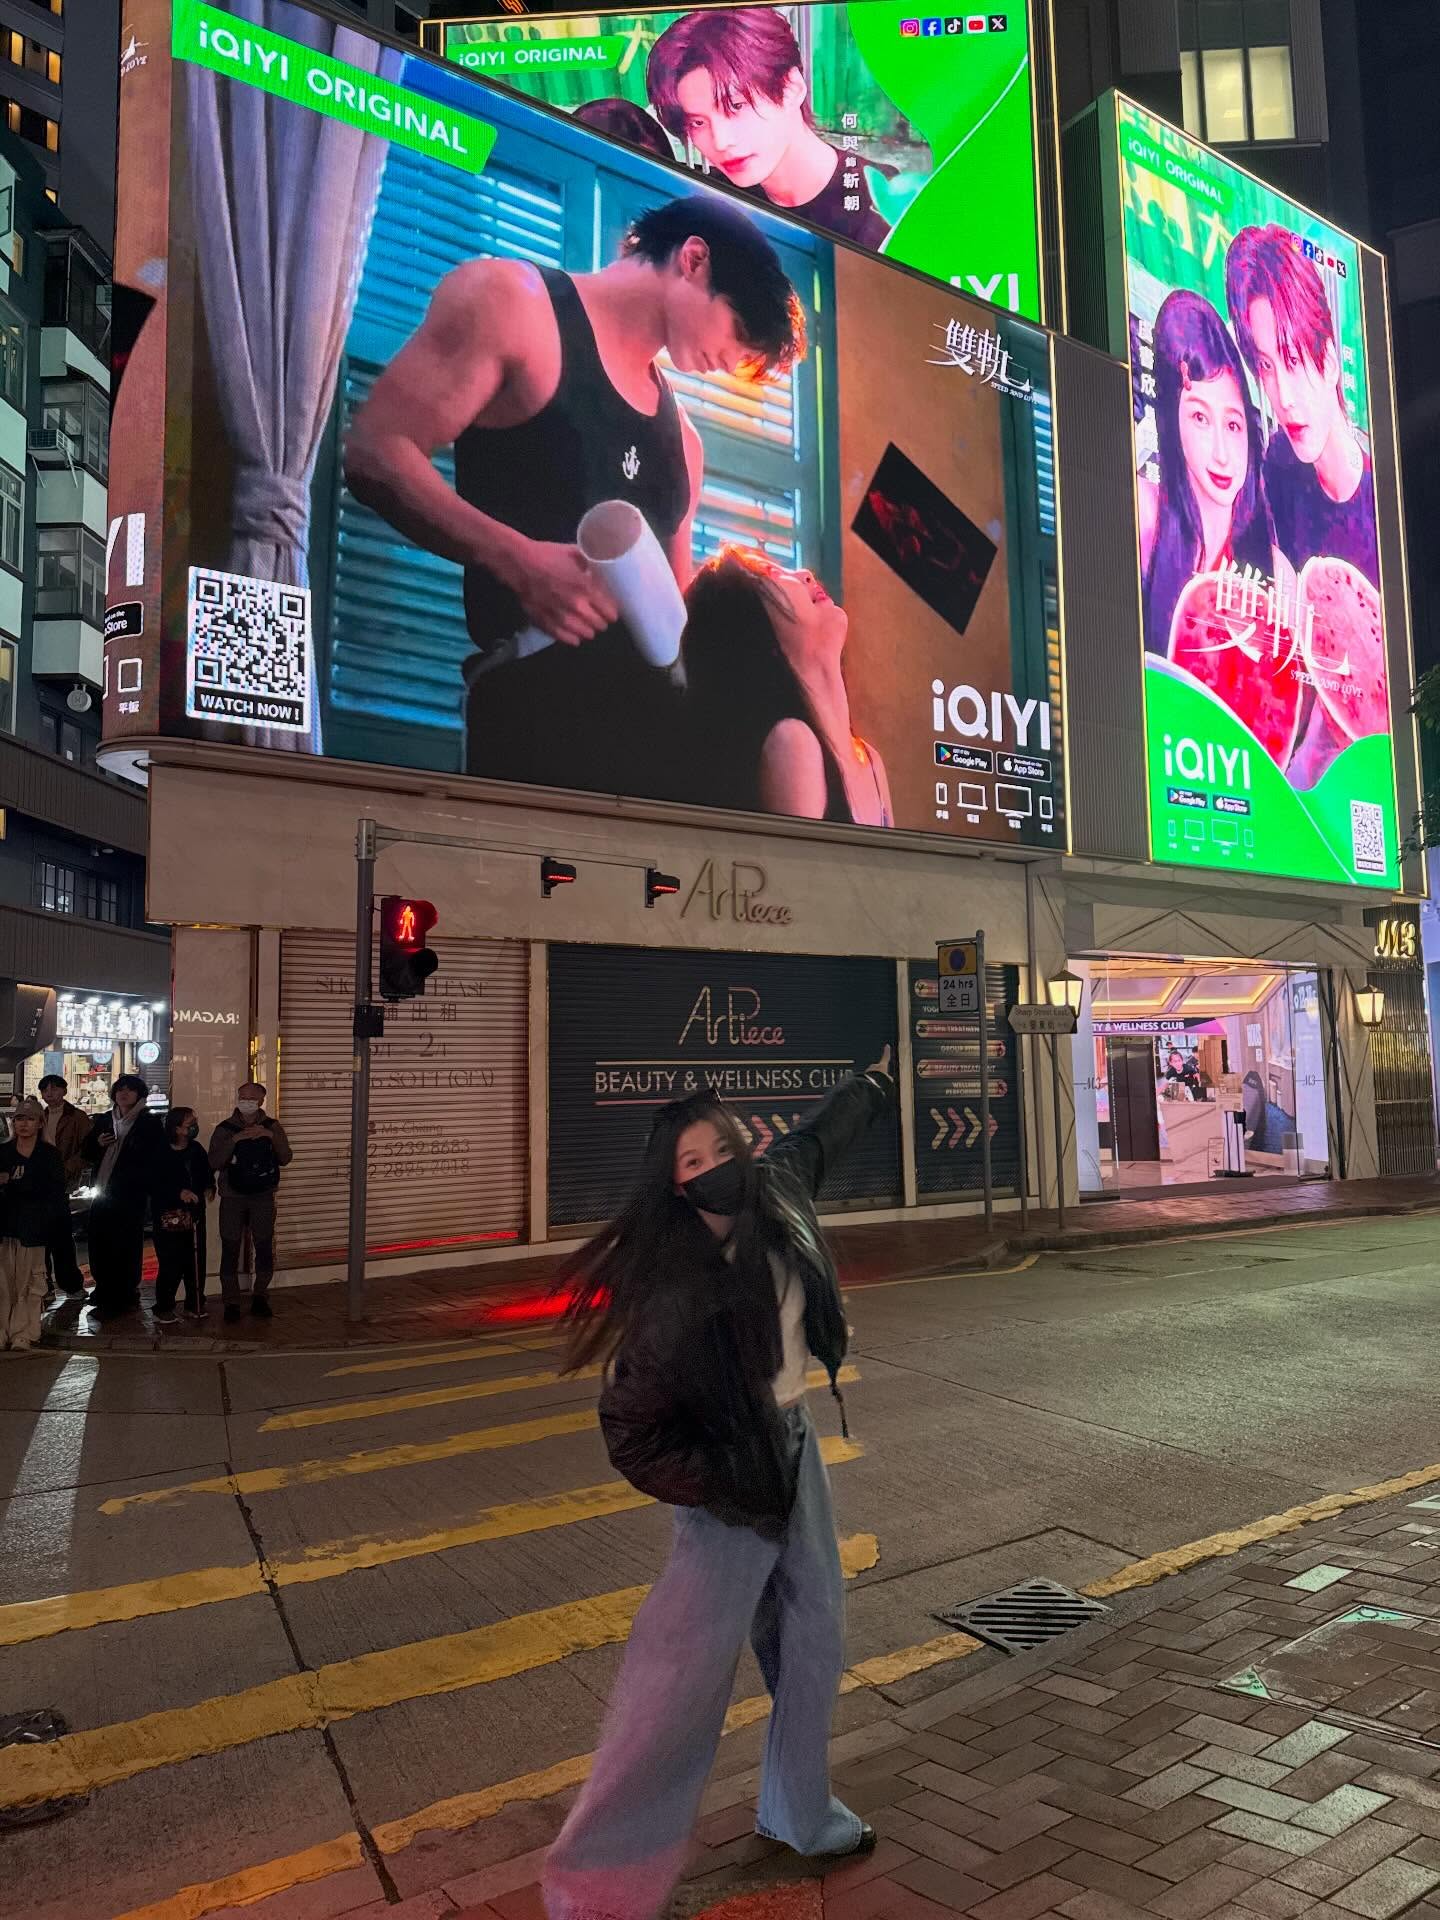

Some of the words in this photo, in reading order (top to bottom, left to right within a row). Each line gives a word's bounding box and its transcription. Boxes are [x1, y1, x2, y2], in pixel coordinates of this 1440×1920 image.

[458, 51, 505, 67] iQIYI
[514, 46, 607, 63] ORIGINAL
[199, 20, 289, 81] iQIYI
[307, 68, 468, 154] ORIGINAL
[1128, 137, 1160, 167] iQIYI
[1165, 159, 1224, 204] ORIGINAL
[200, 694, 254, 715] WATCH
[932, 678, 1051, 750] iQIYI
[953, 754, 975, 766] Google
[975, 757, 988, 769] Play
[1013, 764, 1026, 775] App
[1027, 767, 1045, 777] Store
[1163, 733, 1251, 790] iQIYI
[943, 979, 956, 990] 24
[958, 979, 974, 989] hrs
[946, 992, 970, 1008] 全日
[948, 1025, 980, 1033] TREATMEN
[1105, 1022, 1112, 1032] &
[1113, 1021, 1159, 1031] WELLNESS
[1160, 1021, 1185, 1031] CLUB
[594, 1070, 678, 1094] BEAUTY
[683, 1070, 698, 1091] &
[704, 1069, 803, 1090] WELLNESS
